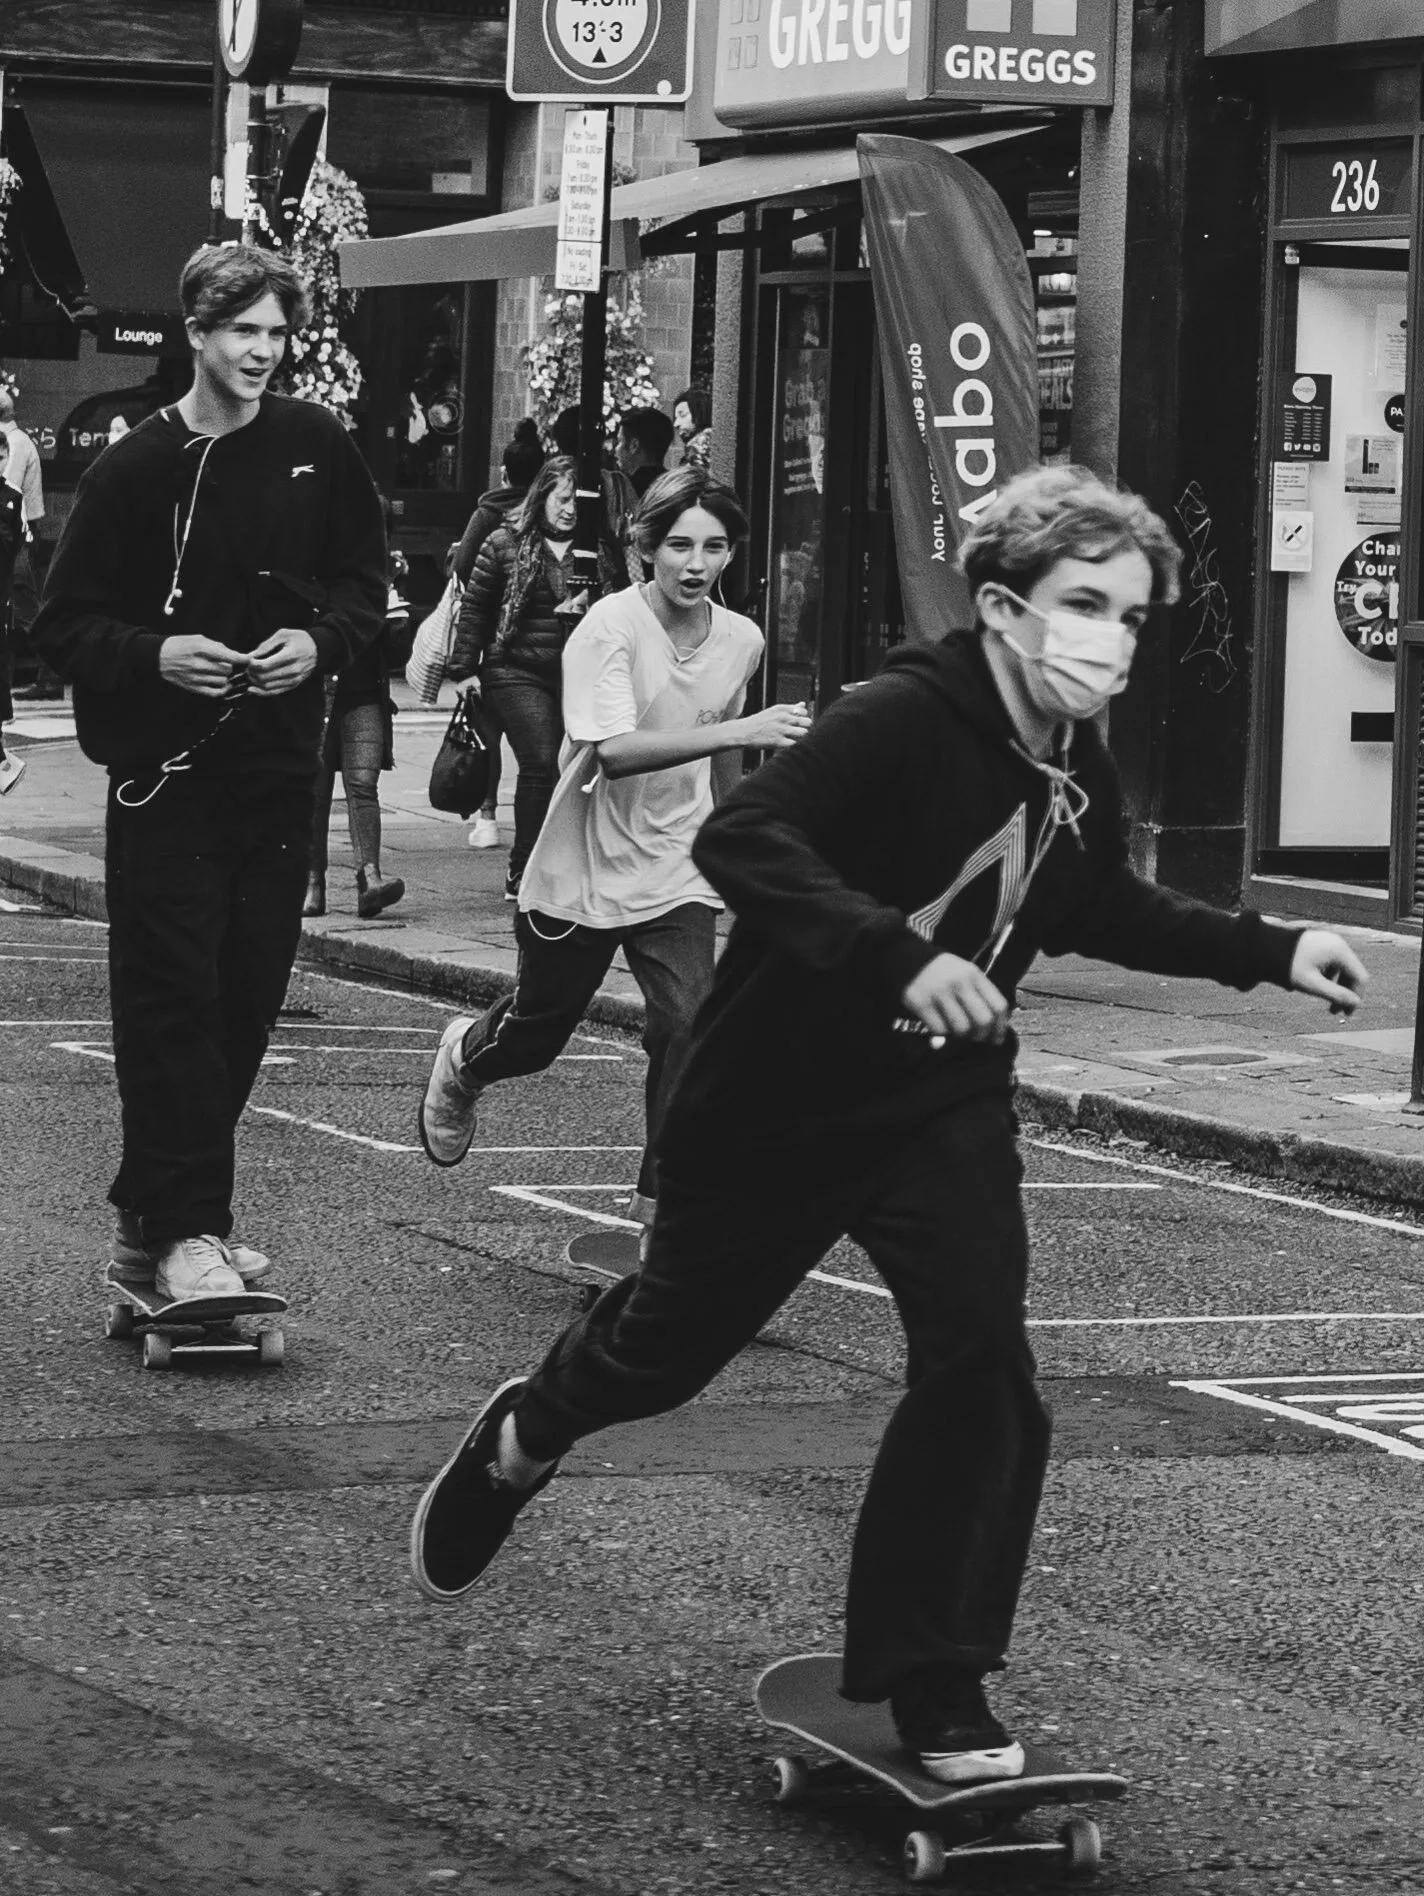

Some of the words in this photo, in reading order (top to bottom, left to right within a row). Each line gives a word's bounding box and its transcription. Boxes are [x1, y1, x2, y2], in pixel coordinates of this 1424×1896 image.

[945, 44, 1097, 86] GREGGS
[1331, 159, 1380, 213] 236
[115, 327, 163, 346] Lounge
[1354, 560, 1397, 577] Your
[1358, 626, 1398, 646] Tod
